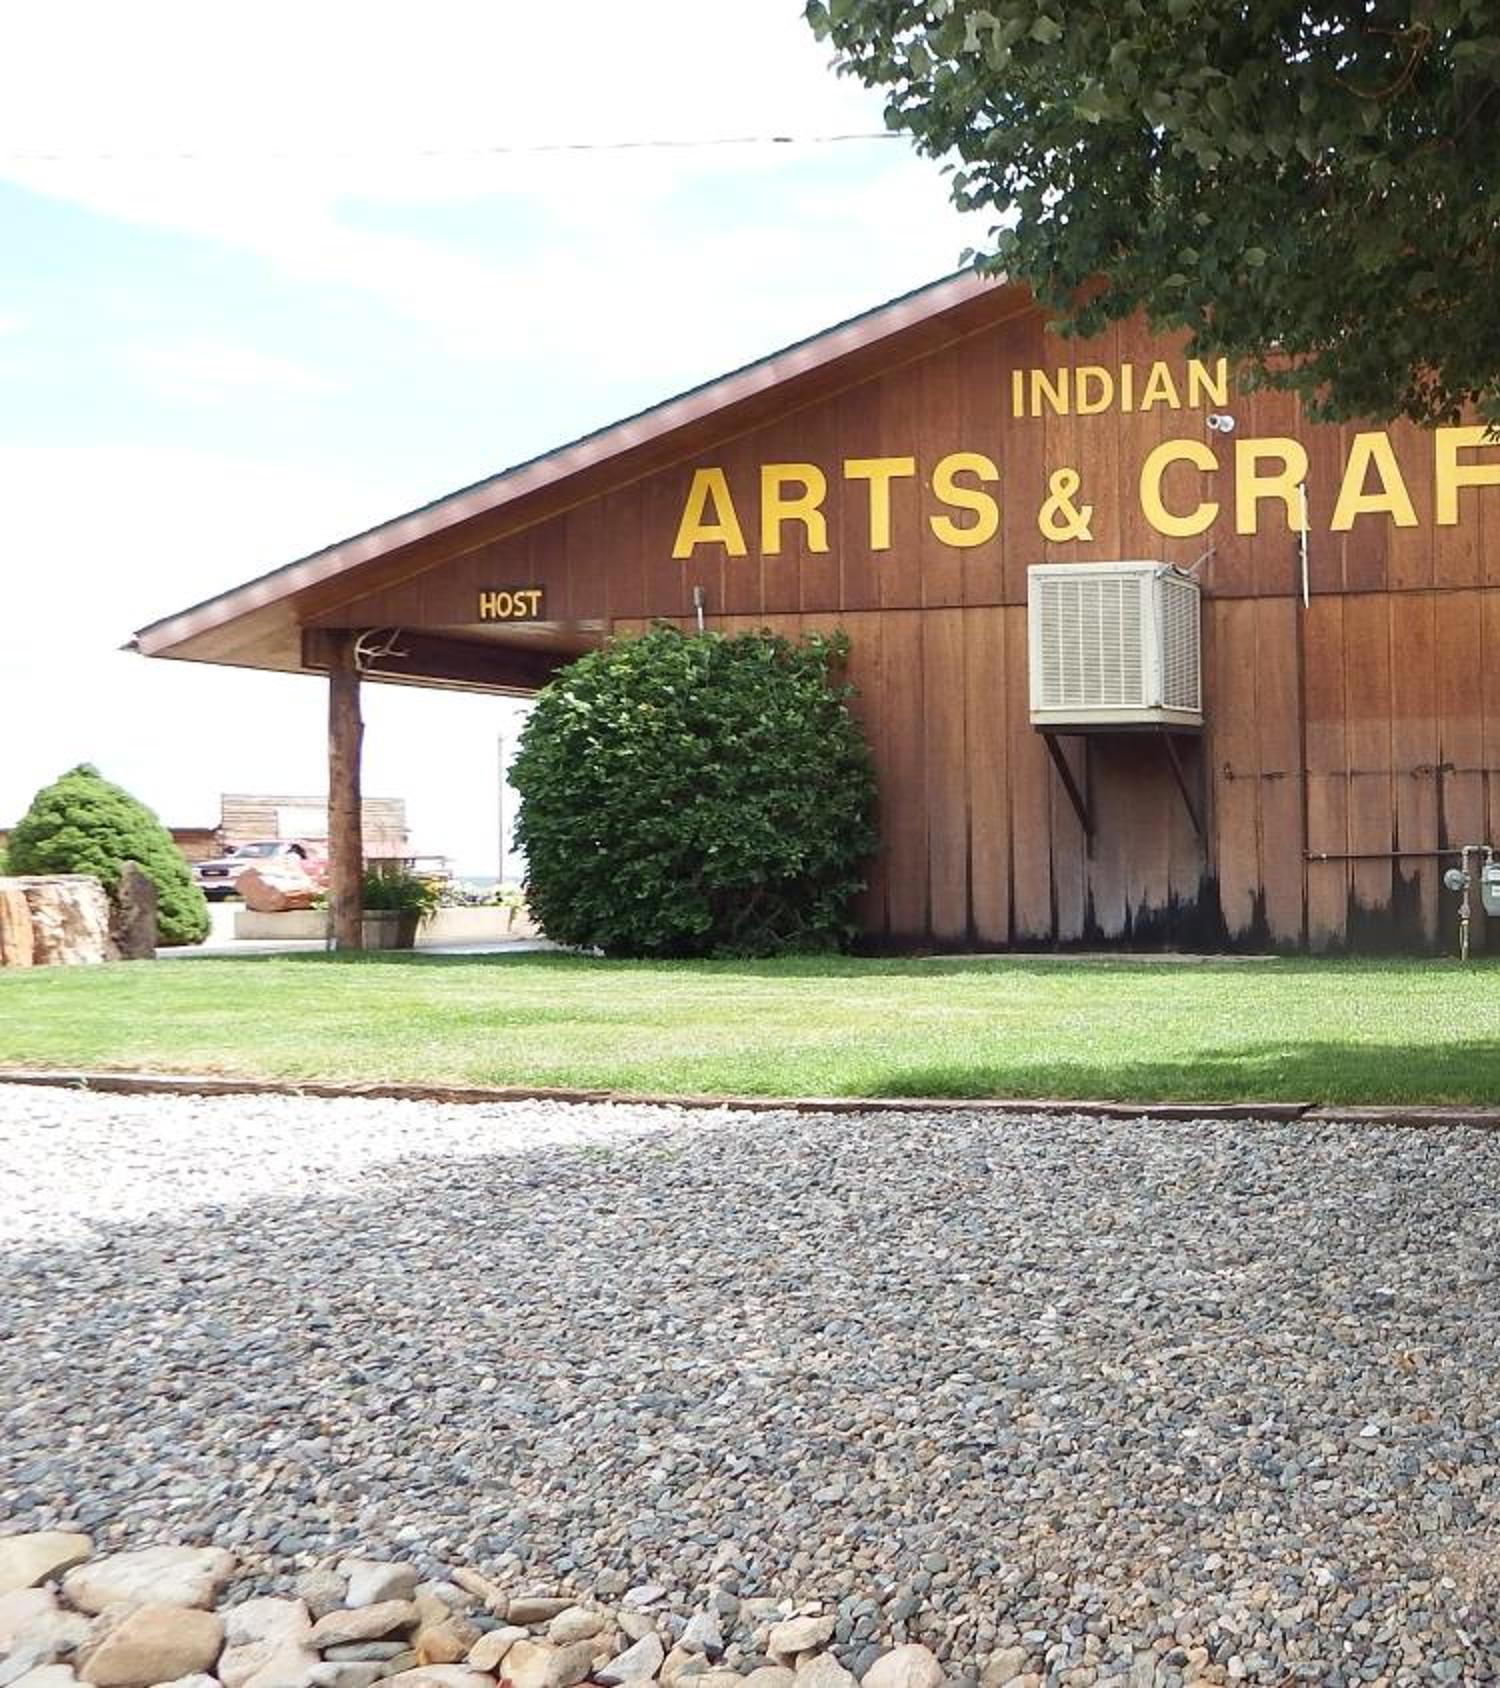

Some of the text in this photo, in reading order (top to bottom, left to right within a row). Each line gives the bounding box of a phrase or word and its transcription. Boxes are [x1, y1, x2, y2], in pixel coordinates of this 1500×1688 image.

[1012, 357, 1228, 418] INDIAN
[671, 451, 1001, 559] ARTS
[1037, 467, 1094, 542] &
[480, 589, 543, 619] HOST
